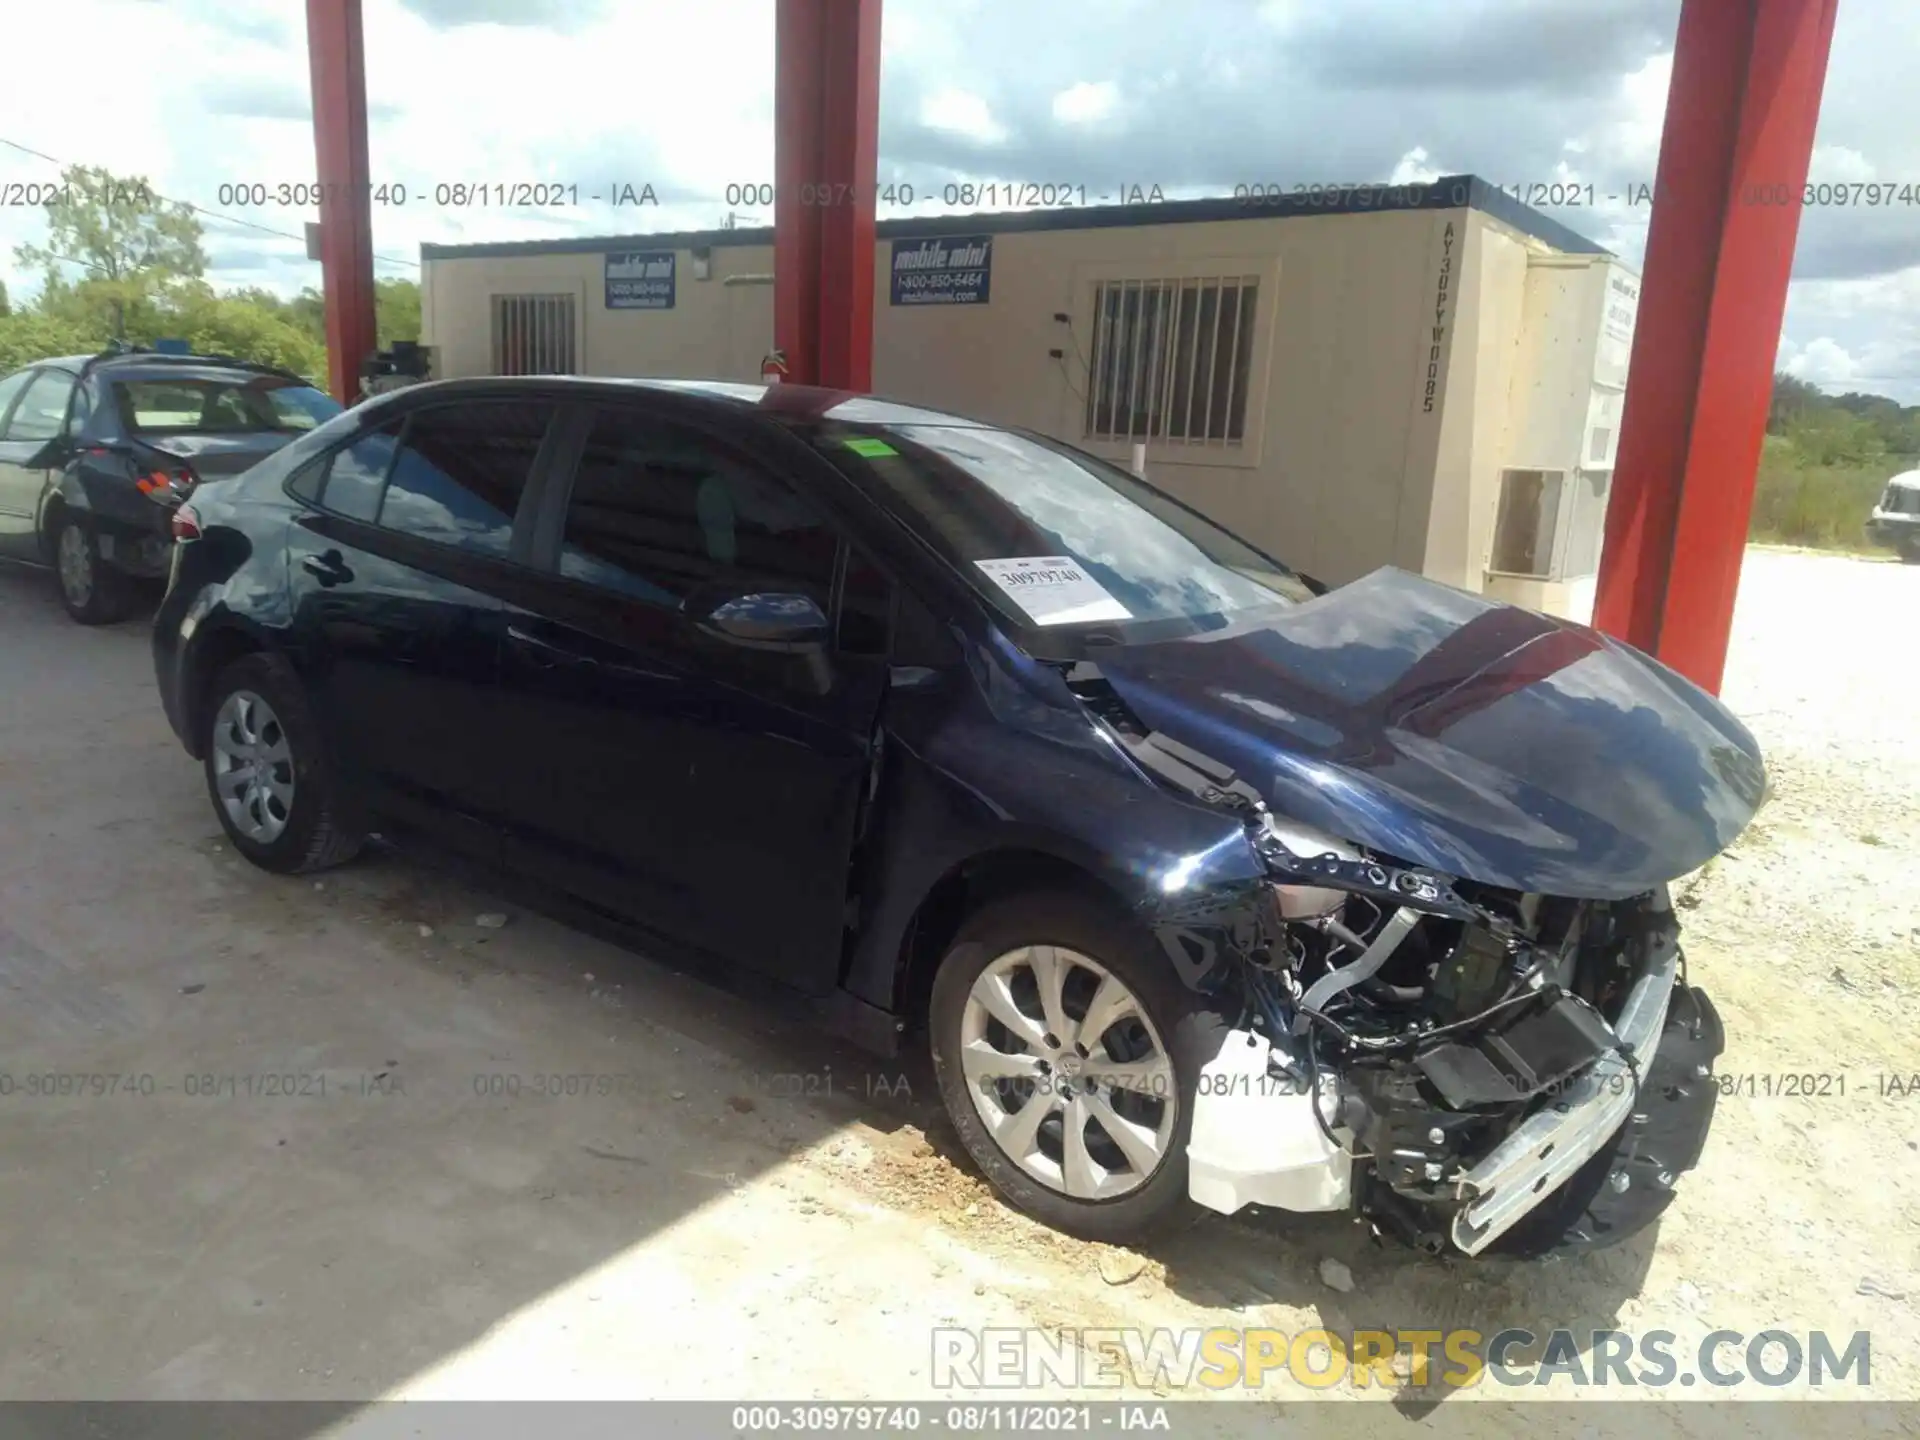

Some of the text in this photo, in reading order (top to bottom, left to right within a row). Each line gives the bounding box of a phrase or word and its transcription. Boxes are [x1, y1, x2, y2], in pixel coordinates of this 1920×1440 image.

[895, 241, 988, 269] mobile mini
[1000, 568, 1082, 586] 30979740
